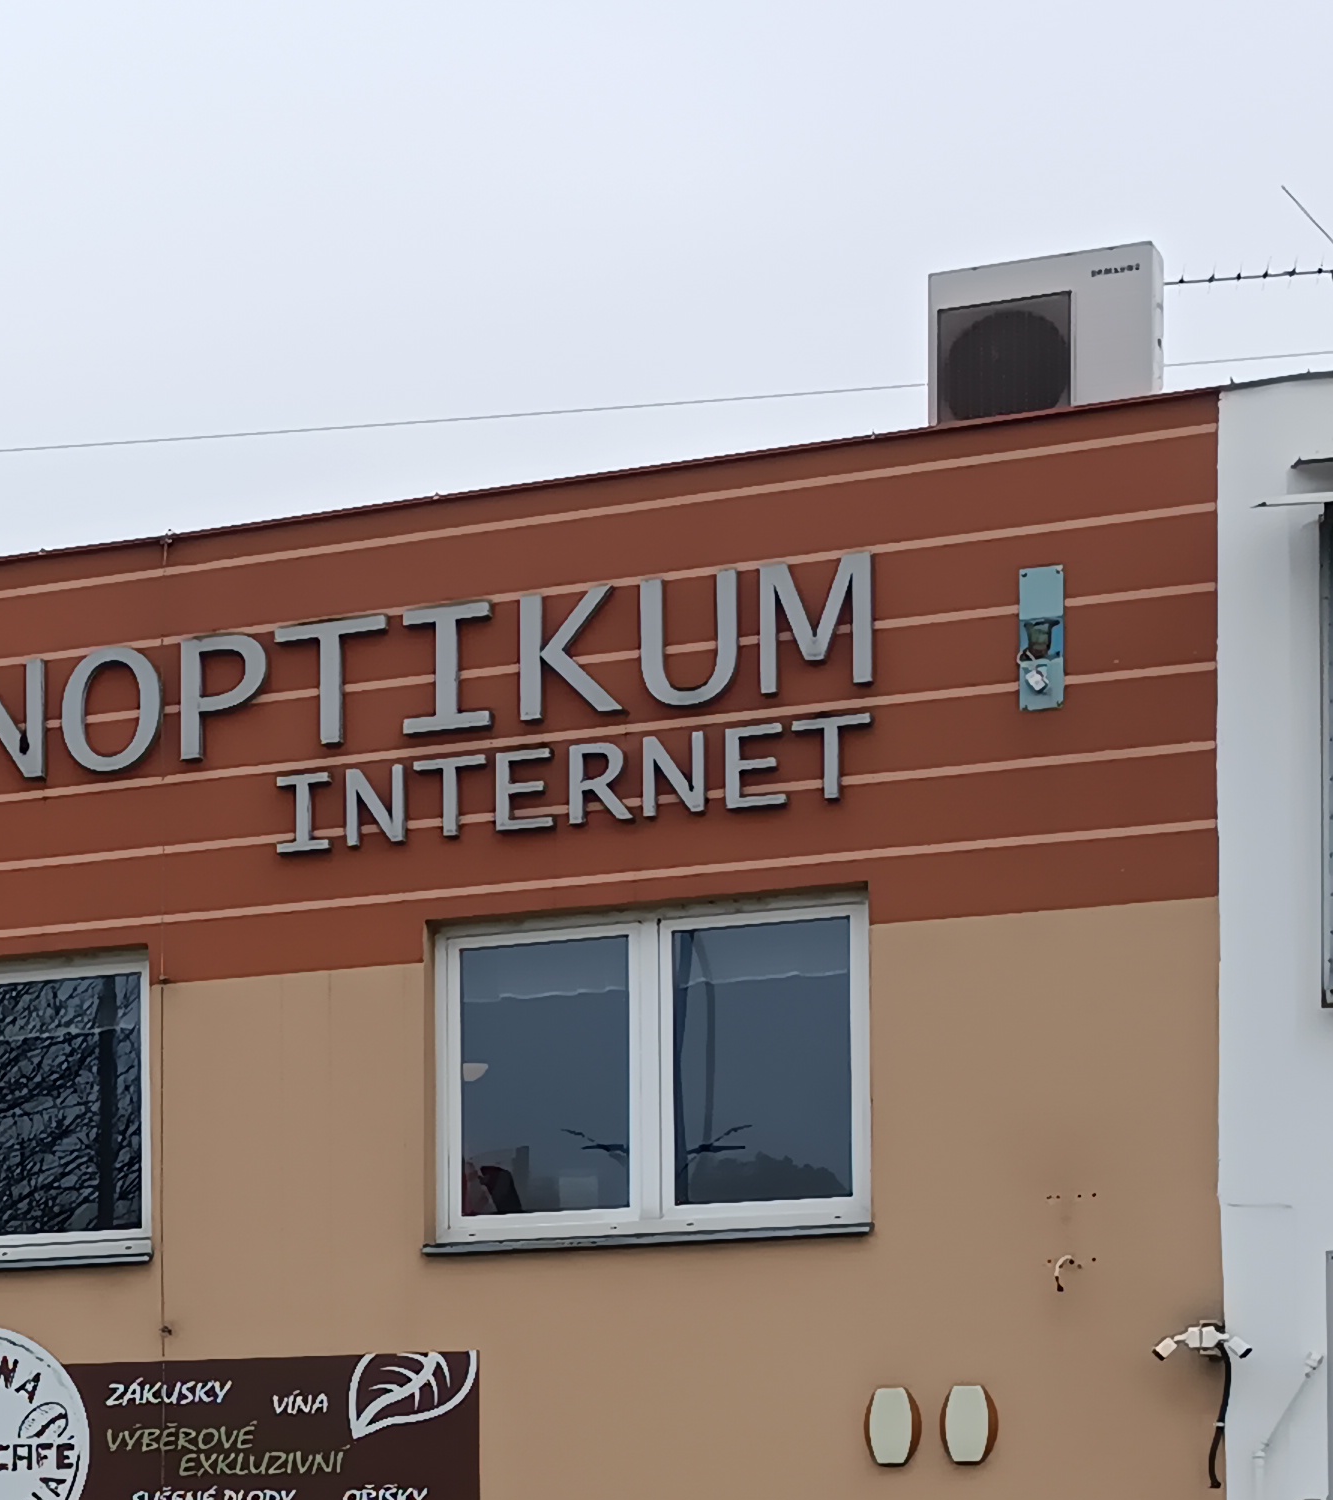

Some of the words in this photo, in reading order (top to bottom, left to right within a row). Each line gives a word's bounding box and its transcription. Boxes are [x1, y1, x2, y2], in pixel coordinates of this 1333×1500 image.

[276, 711, 874, 857] INTERNET
[105, 1378, 233, 1406] ZÁKUSKY
[272, 1390, 329, 1416] VÍNA
[106, 1420, 258, 1452] VÝBĚROVÉ
[178, 1444, 351, 1477] EXKLUZIVNÍ
